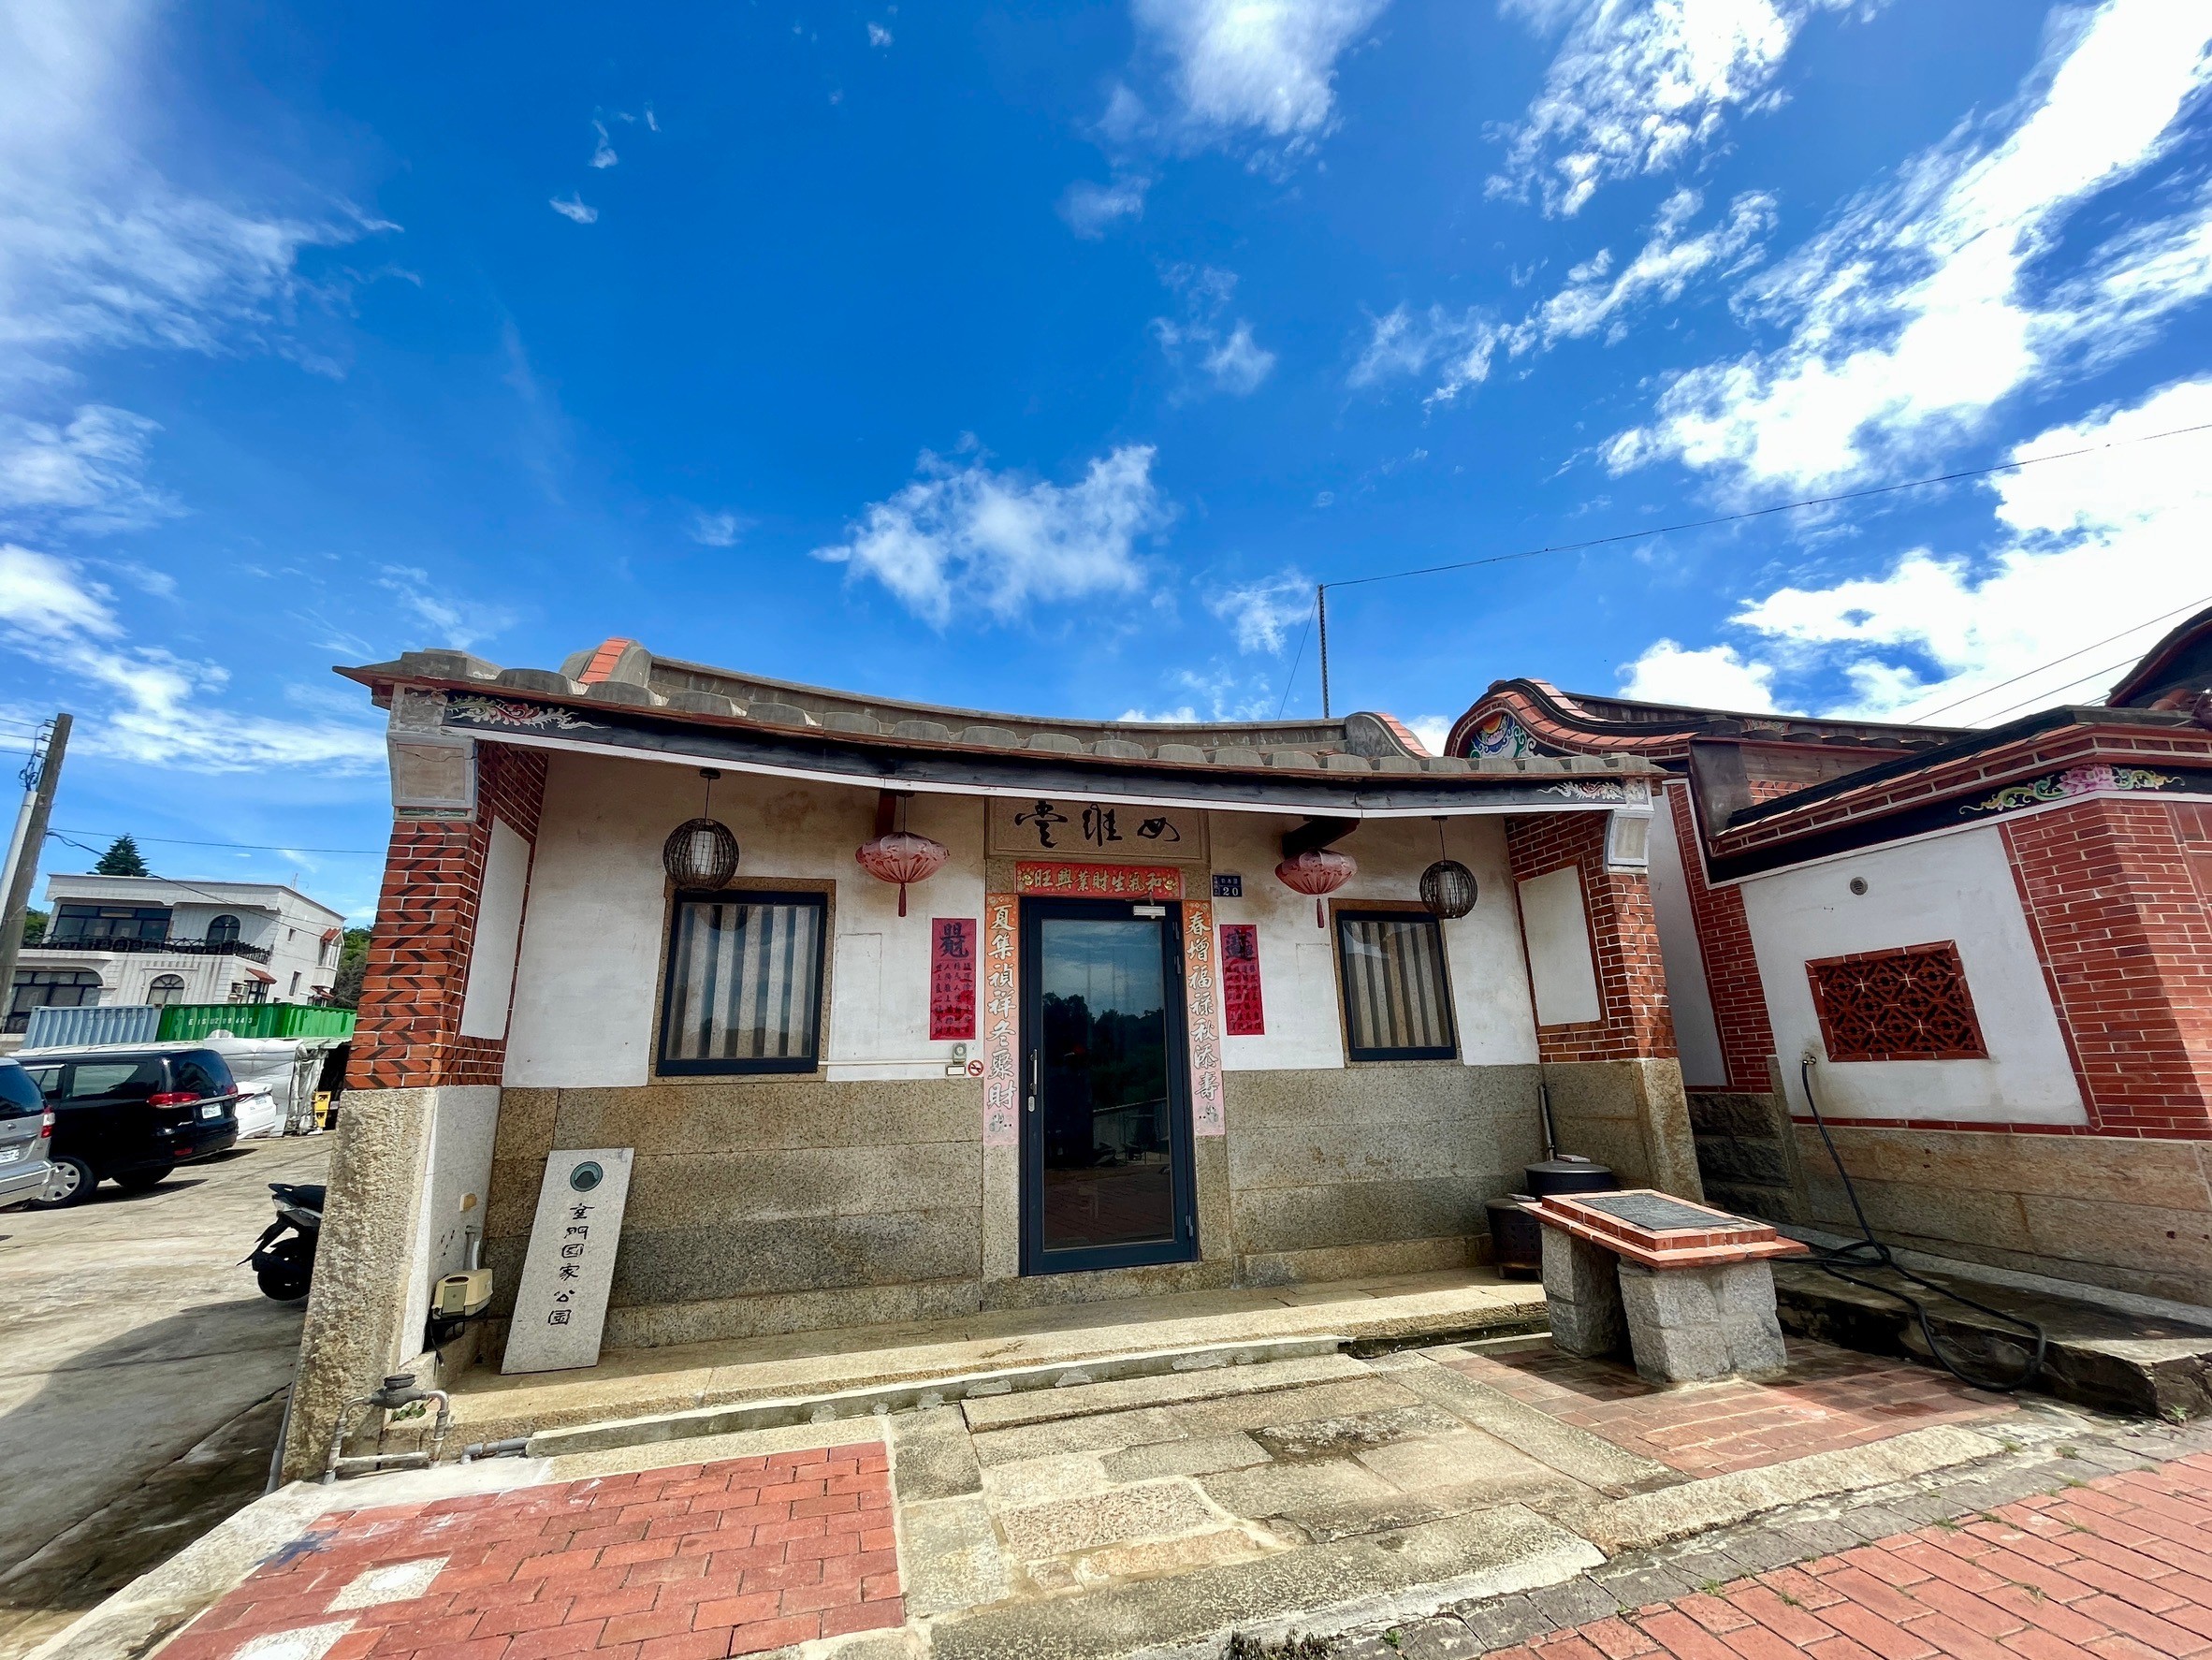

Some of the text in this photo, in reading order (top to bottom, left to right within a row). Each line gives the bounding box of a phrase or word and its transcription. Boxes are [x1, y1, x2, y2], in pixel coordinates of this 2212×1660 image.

[1223, 886, 1239, 896] 20
[985, 903, 1017, 1111] 夏集禎祥冬聚財
[547, 1202, 595, 1326] 金門國家公園
